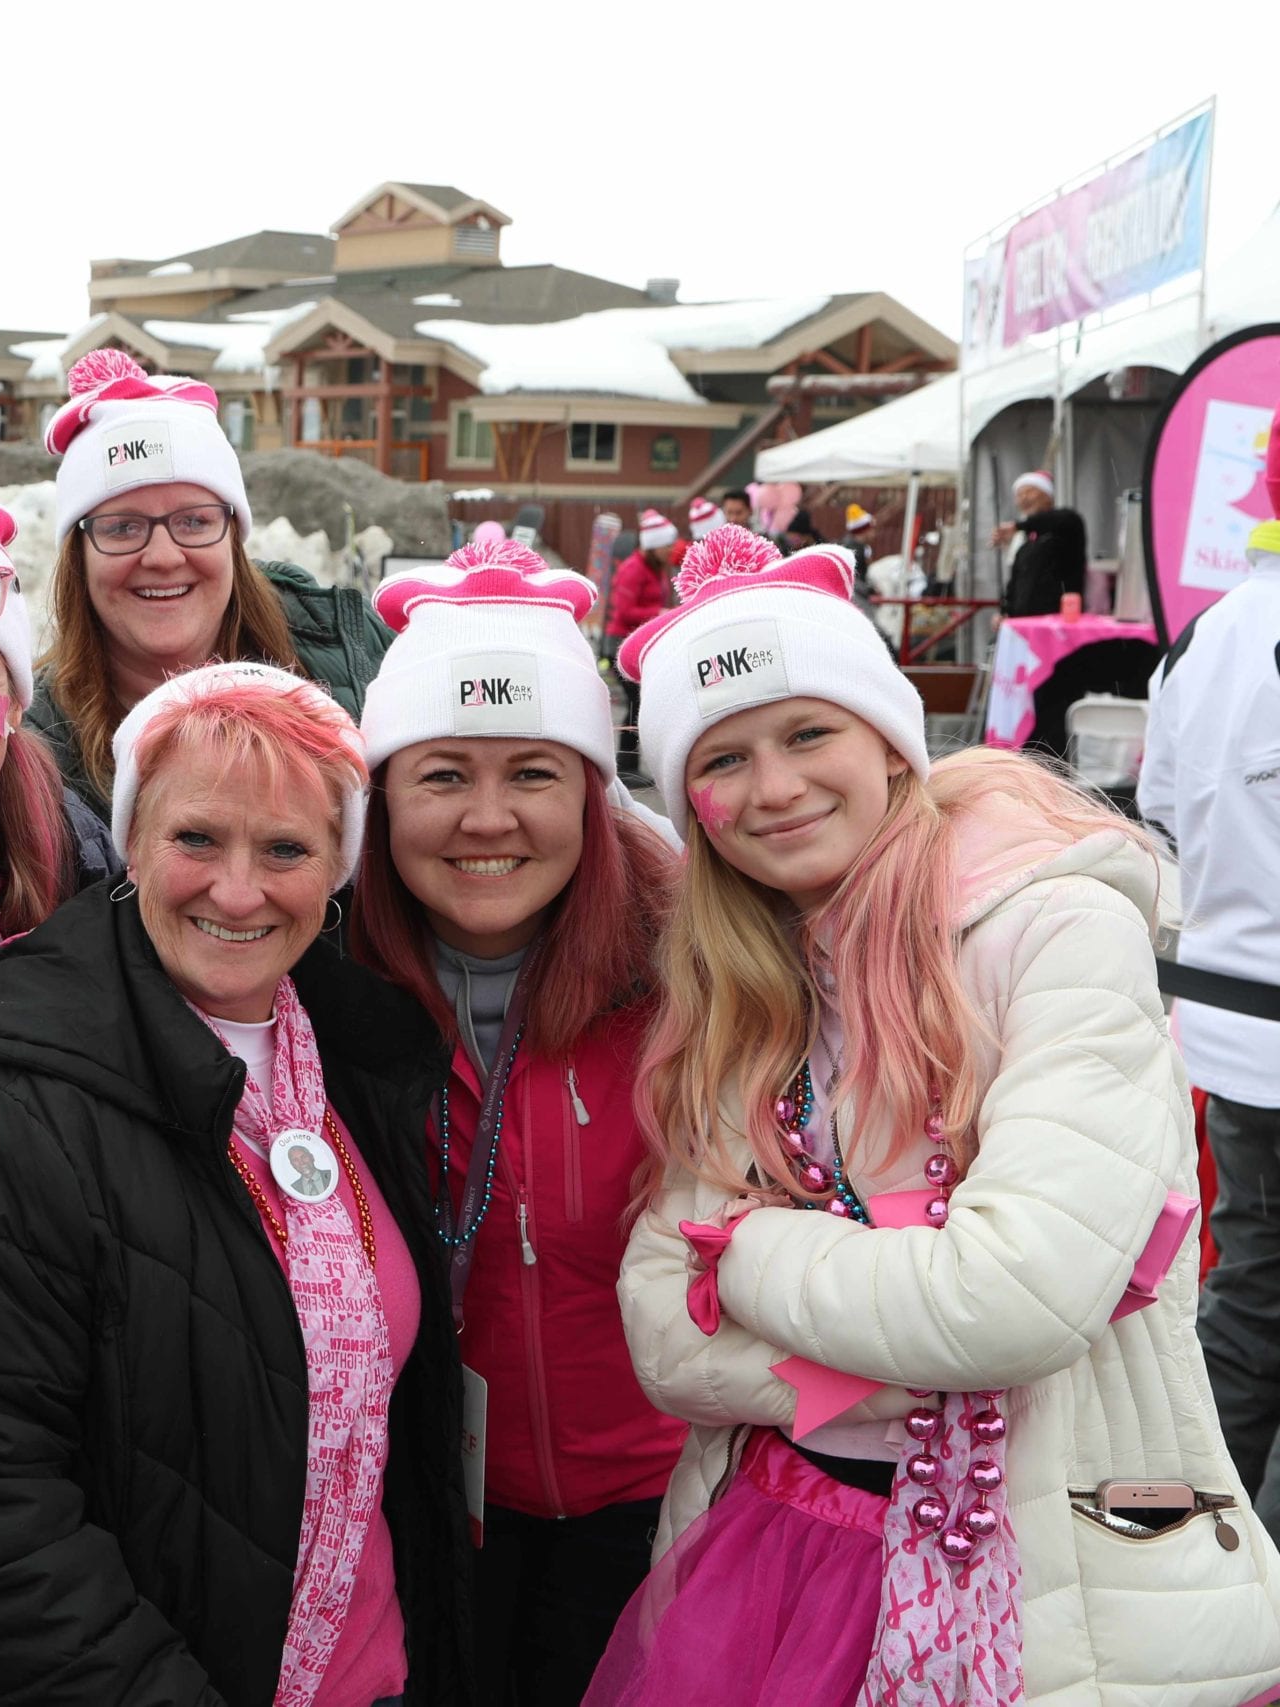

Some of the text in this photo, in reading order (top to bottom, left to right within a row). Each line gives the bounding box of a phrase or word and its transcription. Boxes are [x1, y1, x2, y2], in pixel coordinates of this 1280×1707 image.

[747, 650, 773, 661] PARK
[751, 657, 774, 668] CITY
[509, 685, 532, 693] PARK
[278, 1133, 311, 1147] Our Hero
